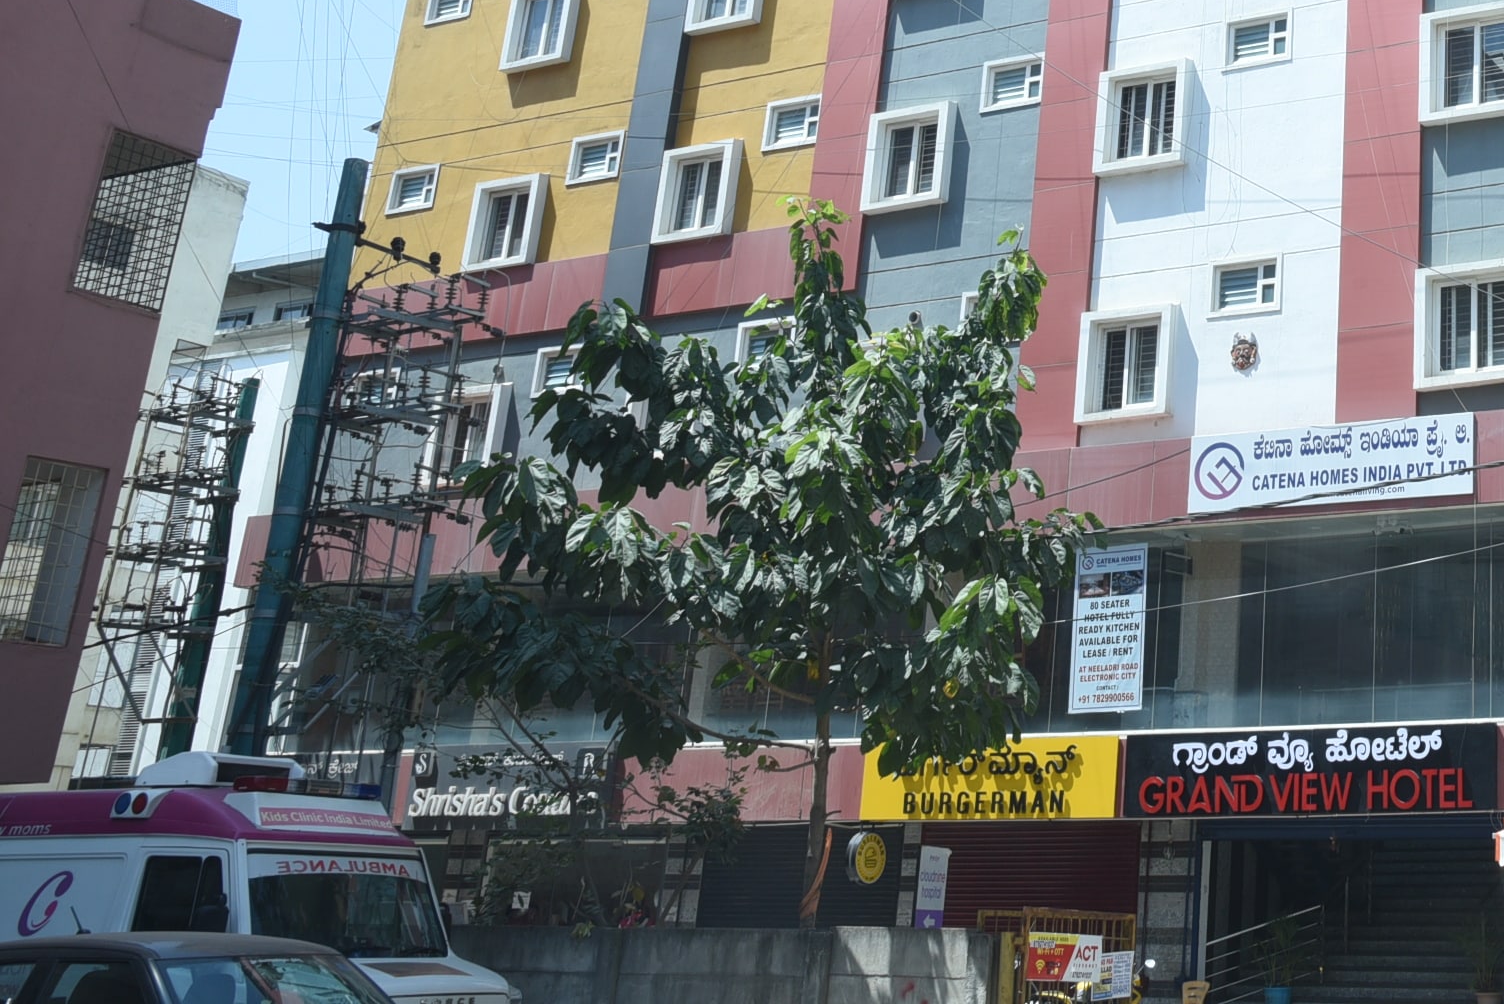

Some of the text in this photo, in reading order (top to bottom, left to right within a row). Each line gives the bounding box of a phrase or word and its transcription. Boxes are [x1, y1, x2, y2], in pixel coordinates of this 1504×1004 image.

[1252, 471, 1305, 491] CATENA
[1310, 467, 1358, 486] HOMES
[1363, 464, 1402, 483] INDIA
[1407, 461, 1436, 478] PVT.
[1096, 555, 1141, 565] CATENA HOMES
[1101, 599, 1130, 609] SEATER
[1084, 611, 1135, 622] HOTEL FULLY
[1079, 622, 1140, 634] READY KITCHEN
[1079, 635, 1138, 646] AVAILABLE FOR
[1083, 649, 1107, 658] LEASE
[1113, 647, 1134, 656] RENT
[1088, 664, 1119, 672] NEELADRI
[1080, 672, 1136, 682] ELECTRONIC CITY
[1078, 695, 1090, 703] +91
[1173, 735, 1258, 774] ಗ್ರಾಂಡ್
[1325, 728, 1442, 763] ಹೋಟೆಲ್
[1139, 768, 1473, 814] GRAND VIEW HOTEL
[408, 785, 506, 817] Shrisha's
[902, 790, 1064, 814] BURGERMAN
[261, 811, 392, 829] Kids Clinic India Limited
[8, 824, 51, 836] moms
[1074, 945, 1098, 962] ACT
